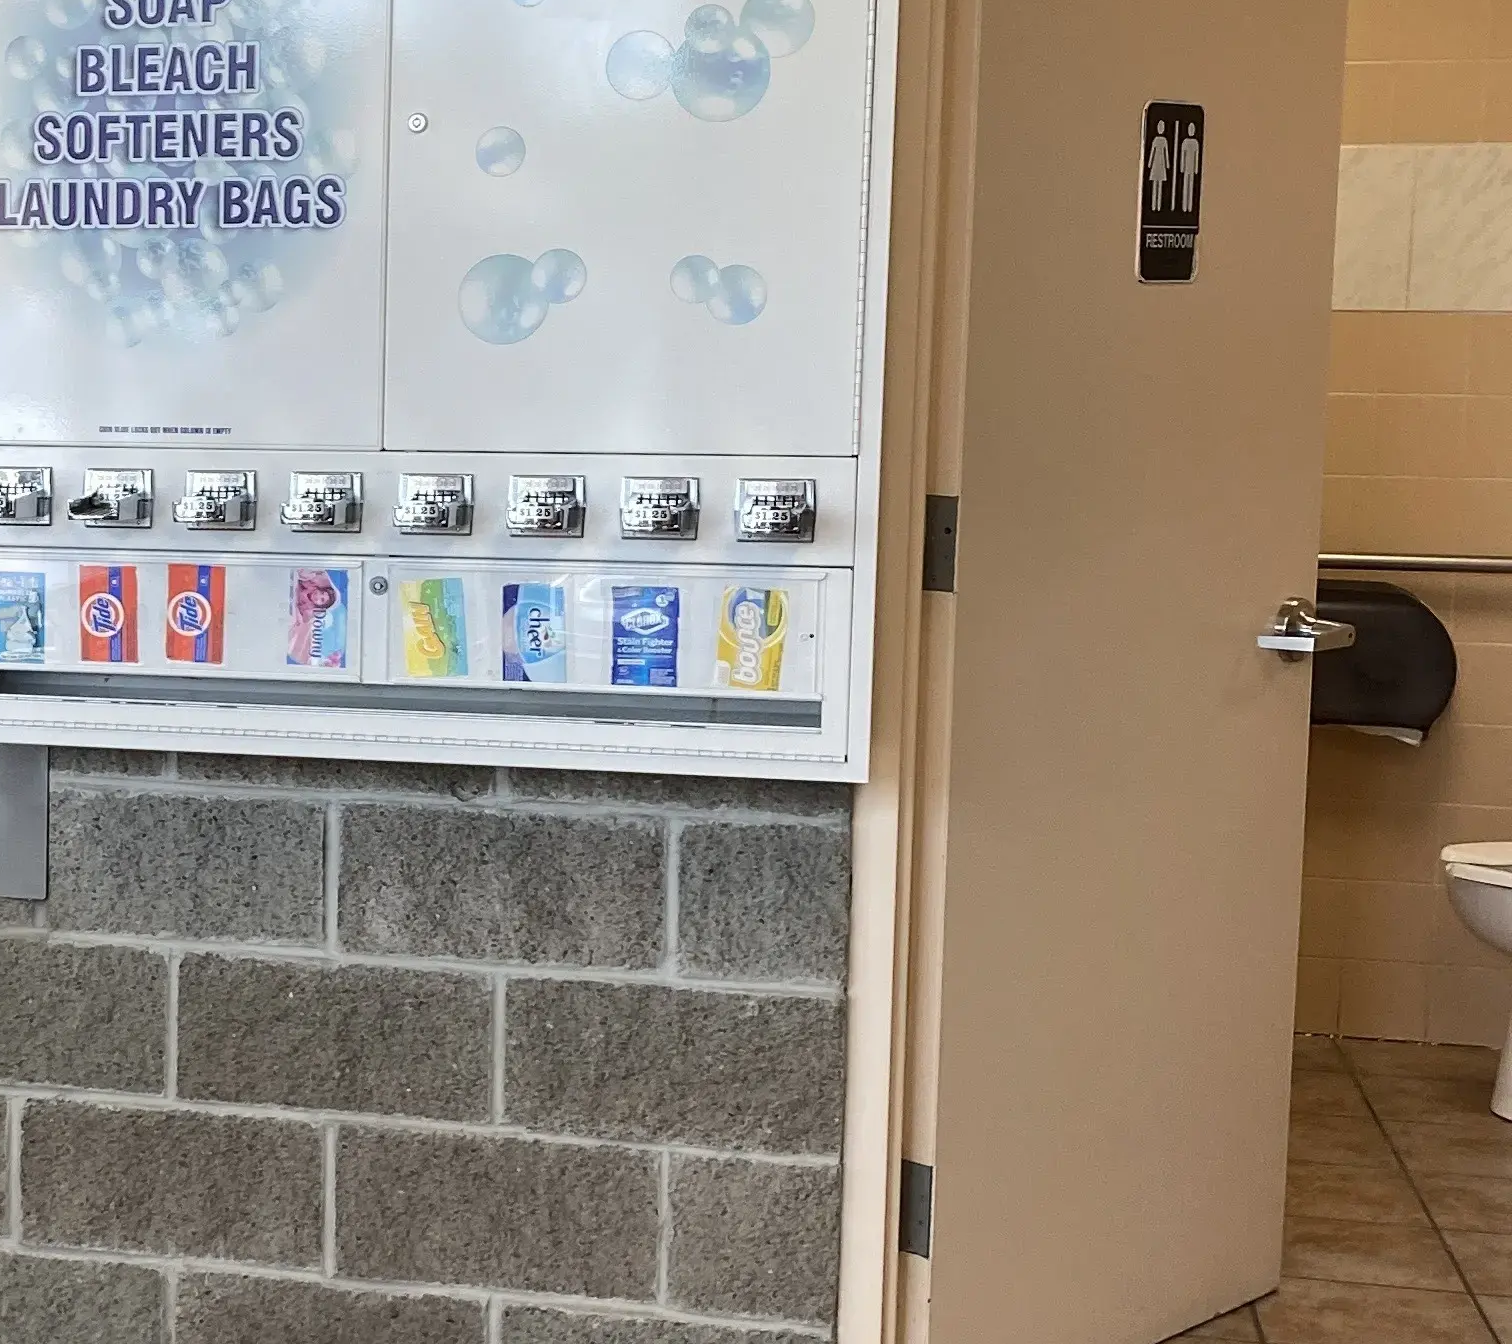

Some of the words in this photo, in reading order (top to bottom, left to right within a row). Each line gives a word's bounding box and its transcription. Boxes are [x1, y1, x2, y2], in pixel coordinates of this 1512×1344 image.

[77, 43, 257, 94] BLEACH
[35, 111, 303, 161] SOFTENERS
[218, 177, 344, 226] BAGS
[1145, 233, 1194, 248] RESTROOM
[98, 493, 128, 501] $1.2
[291, 503, 322, 513] $1.25
[405, 506, 436, 515] $1.25
[519, 507, 551, 517] $1.25
[634, 510, 668, 519] $1.25
[754, 511, 788, 521] $1.25
[92, 596, 116, 633] Tide
[179, 595, 203, 632] Tide
[527, 607, 550, 653] cheer
[309, 609, 326, 658] Downy
[733, 603, 760, 683] bounce
